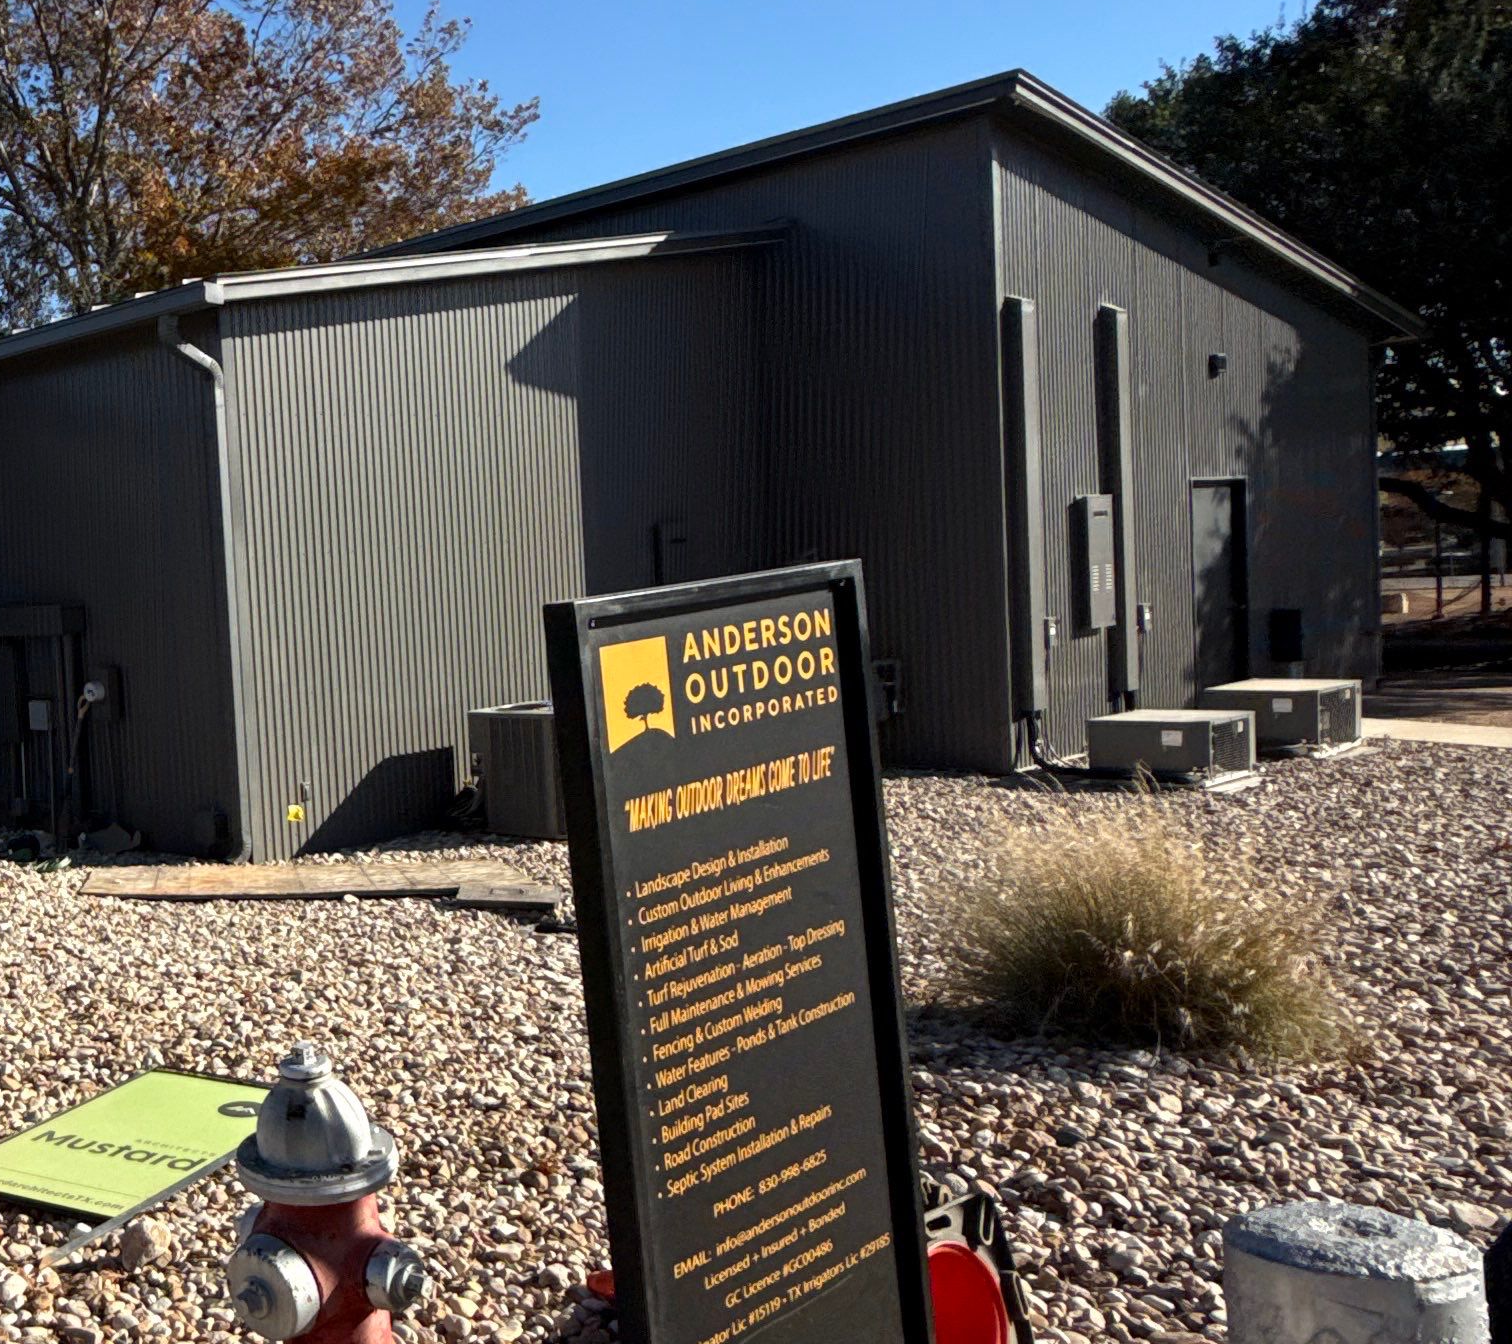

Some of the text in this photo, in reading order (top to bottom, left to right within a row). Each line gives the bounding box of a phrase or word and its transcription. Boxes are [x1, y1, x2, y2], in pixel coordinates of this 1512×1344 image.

[683, 608, 831, 664] ANDERSON
[685, 647, 835, 704] OUTDOOR
[691, 685, 838, 735] INCORPORATED
[675, 775, 724, 819] OUTDOOR
[726, 763, 766, 805] DREAMS
[768, 755, 796, 793] COME
[798, 752, 810, 785] TO
[635, 836, 789, 898] Landscape Design & Installation
[638, 847, 831, 925] Custom Outdoor Living & Enhancements
[641, 886, 793, 953] Irrigation & Water Management
[644, 929, 739, 981] Artificial Turf & Sod
[647, 982, 669, 1007] Turf
[669, 961, 736, 999] Rejuvenation
[742, 943, 783, 970] Aeration
[788, 934, 806, 952] Top
[806, 918, 845, 944] Dressing
[649, 954, 822, 1035] Full Maintenance & Mowing Services
[653, 996, 783, 1062] Fencing & Custom Welding
[655, 1065, 687, 1089] Water
[687, 1045, 731, 1076] Features
[737, 1029, 767, 1053] Ponds
[768, 1023, 776, 1040] &
[776, 1013, 798, 1035] Tank
[798, 991, 855, 1026] Construction
[659, 1074, 729, 1117] Land Clearing
[661, 1091, 750, 1144] Building Pad Sites
[31, 1130, 207, 1171] Mustard
[663, 1115, 756, 1172] Road Construction
[666, 1104, 833, 1199] Septic System Installation & Repairs
[673, 1167, 867, 1280] EMAIL: info@andersonoutdoorinc.com
[704, 1253, 751, 1290] Licensed
[761, 1227, 799, 1258] Insured
[808, 1201, 846, 1233] Bonded
[725, 1291, 742, 1309] GC
[743, 1269, 781, 1299] Licence
[731, 1316, 748, 1336] Lic
[787, 1283, 803, 1303] TX
[802, 1262, 845, 1293] Irrigators
[845, 1253, 859, 1269] Lic
